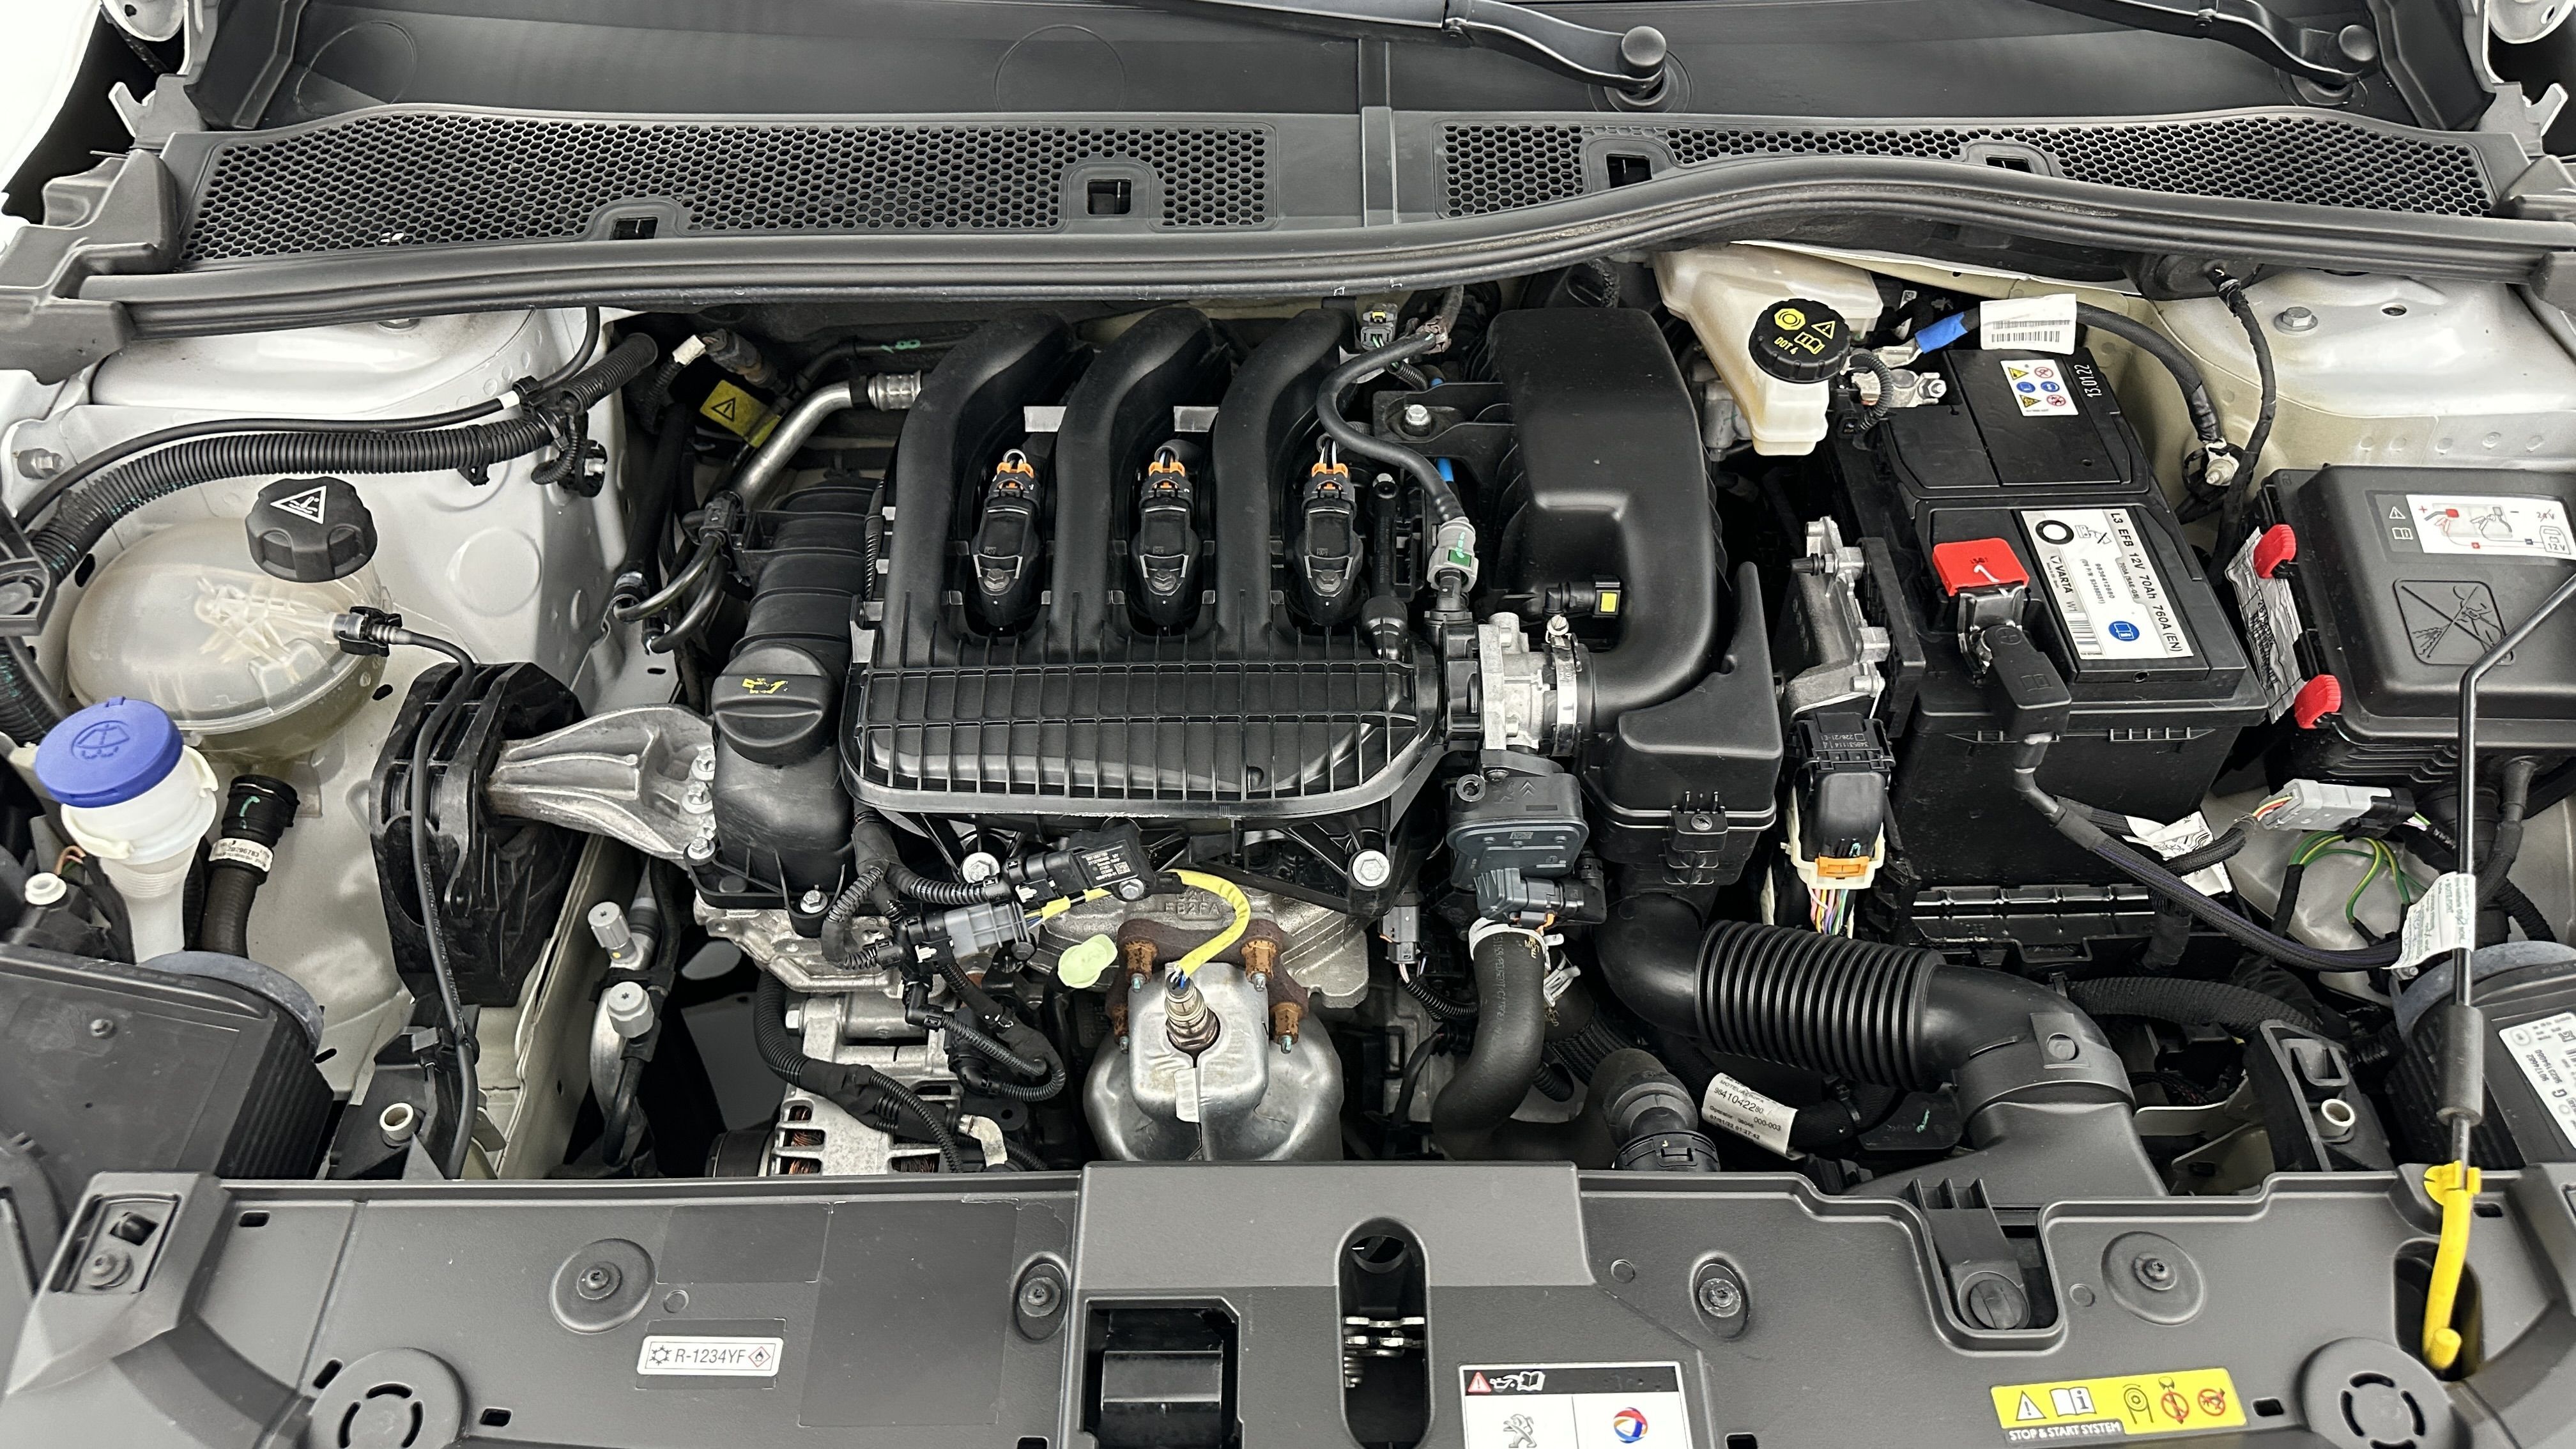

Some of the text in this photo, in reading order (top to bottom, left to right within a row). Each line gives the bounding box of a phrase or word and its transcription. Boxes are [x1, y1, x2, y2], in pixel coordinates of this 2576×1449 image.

[1774, 336, 1798, 355] DOT 4
[2074, 364, 2103, 397] 13.01.22
[2055, 565, 2073, 594] VARTA
[2110, 513, 2183, 652] L3 EFB 12V 70Ah 760A (EN)
[1753, 1116, 1781, 1131] 000-003
[675, 1349, 746, 1364] R-1234YF
[2009, 1422, 2121, 1441] STOP & START SYSTEM
